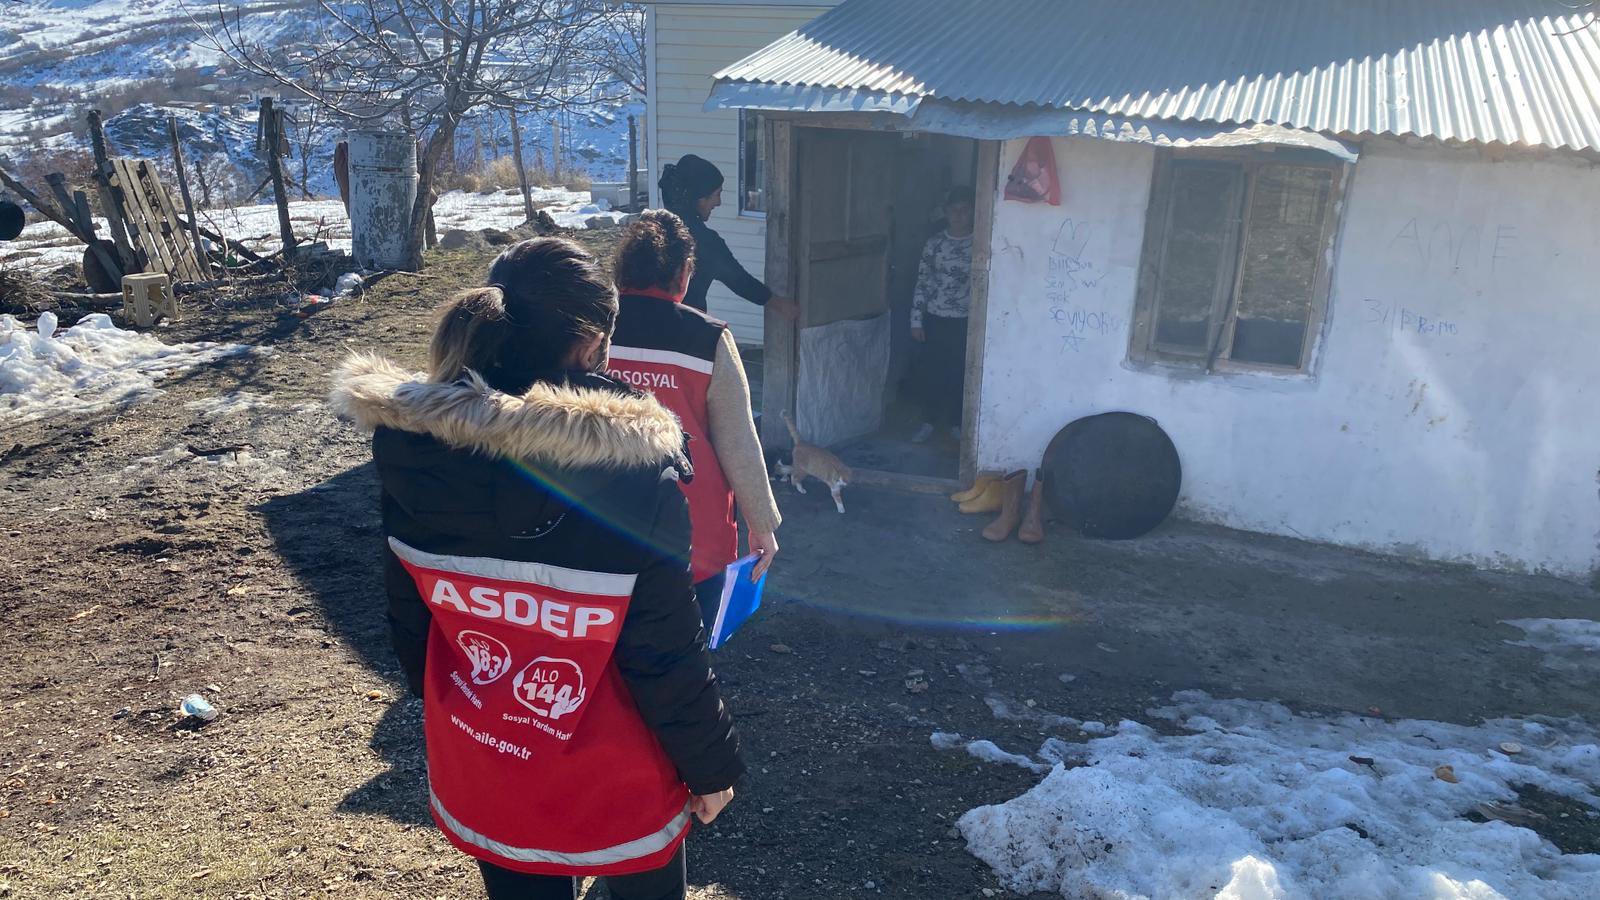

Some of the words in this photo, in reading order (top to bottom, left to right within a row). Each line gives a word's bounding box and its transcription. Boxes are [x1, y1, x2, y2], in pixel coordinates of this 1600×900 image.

[604, 368, 679, 389] OSOSYAL
[431, 578, 615, 638] ASDEP
[531, 668, 559, 683] ALO
[523, 682, 573, 711] 144
[502, 713, 530, 724] Sosyal
[532, 718, 556, 735] Yardım
[450, 714, 532, 760] www.aile.gov.tr
